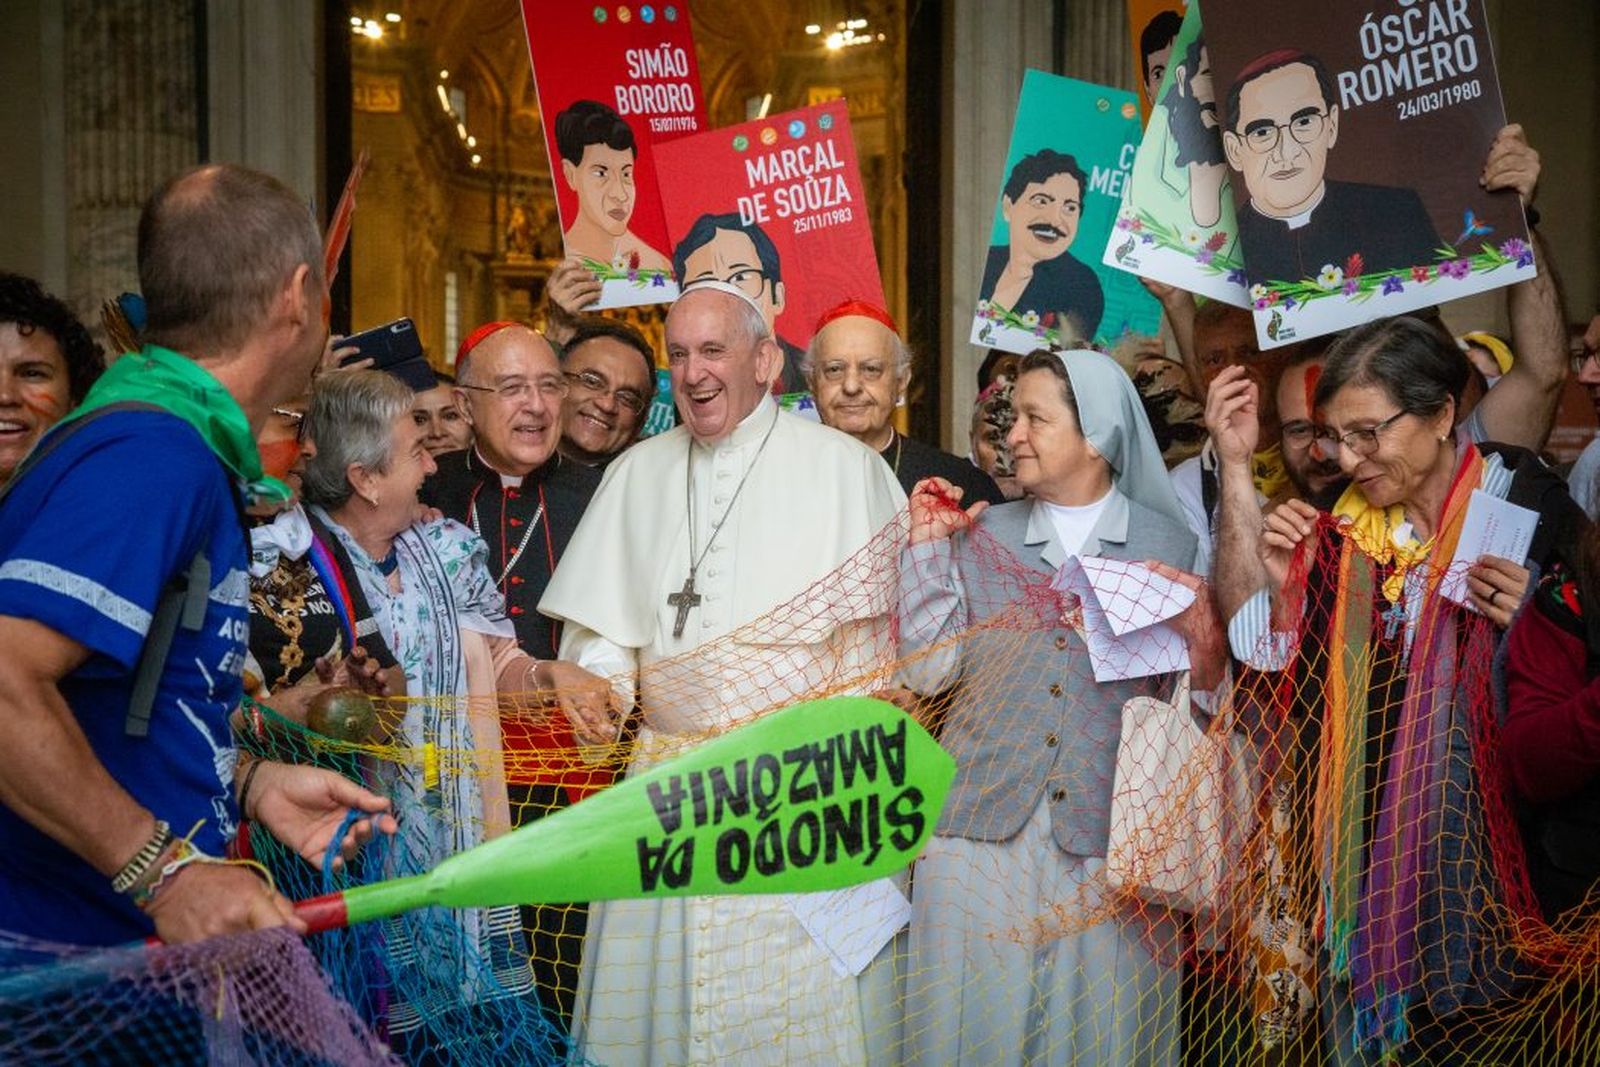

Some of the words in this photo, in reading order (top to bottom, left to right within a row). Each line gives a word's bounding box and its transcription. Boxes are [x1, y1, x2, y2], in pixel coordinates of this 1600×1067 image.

[1359, 0, 1473, 60] ÓSCAR
[625, 43, 689, 79] SIMÃO
[1337, 34, 1478, 110] ROMERO
[614, 83, 695, 116] BORORO
[1397, 79, 1482, 121] 24/03/1980
[744, 139, 845, 188] MARÇAL
[736, 195, 770, 227] DE
[793, 209, 853, 234] 25/11/1983
[645, 717, 907, 836] AMAZÔNIA
[715, 784, 926, 885] SÍNODO
[636, 835, 696, 893] DA
